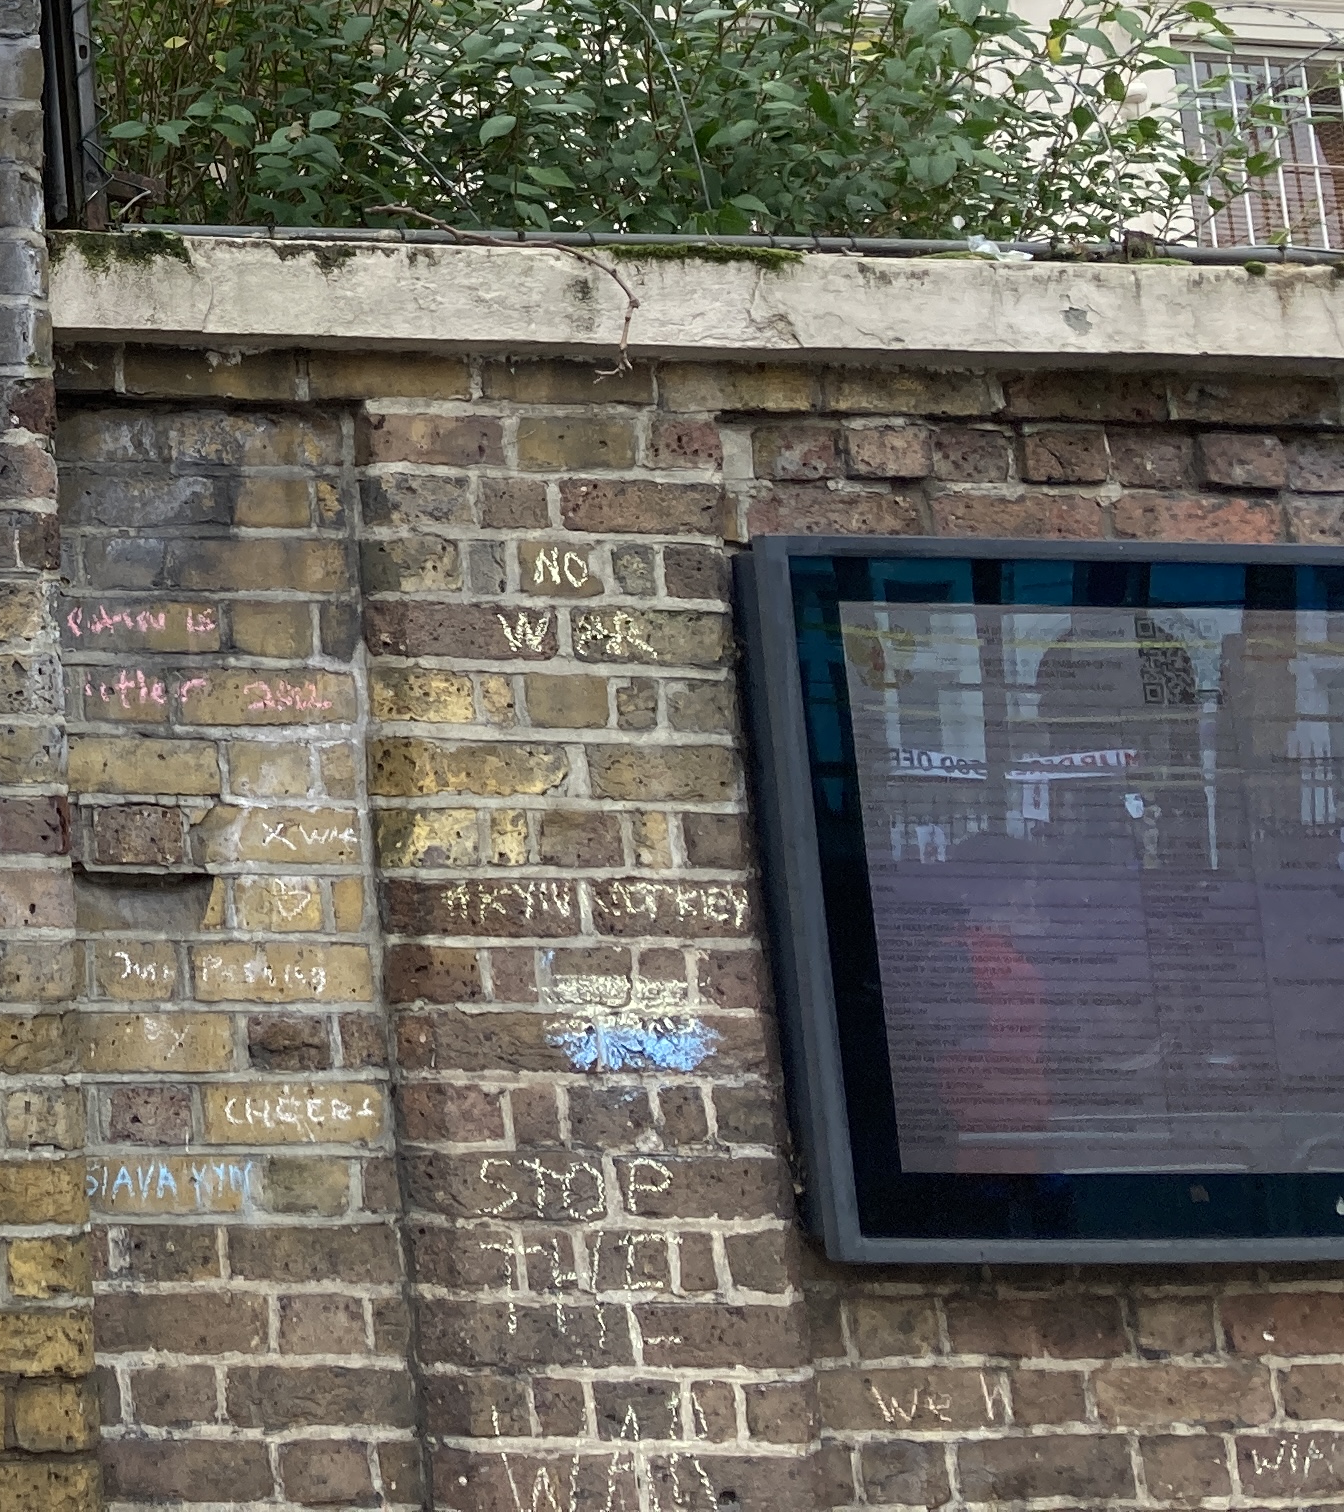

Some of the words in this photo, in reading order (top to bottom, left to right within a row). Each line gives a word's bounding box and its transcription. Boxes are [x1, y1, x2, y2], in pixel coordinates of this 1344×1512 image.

[533, 547, 590, 589] NO
[495, 609, 659, 660] WAR
[474, 1156, 674, 1222] STOP
